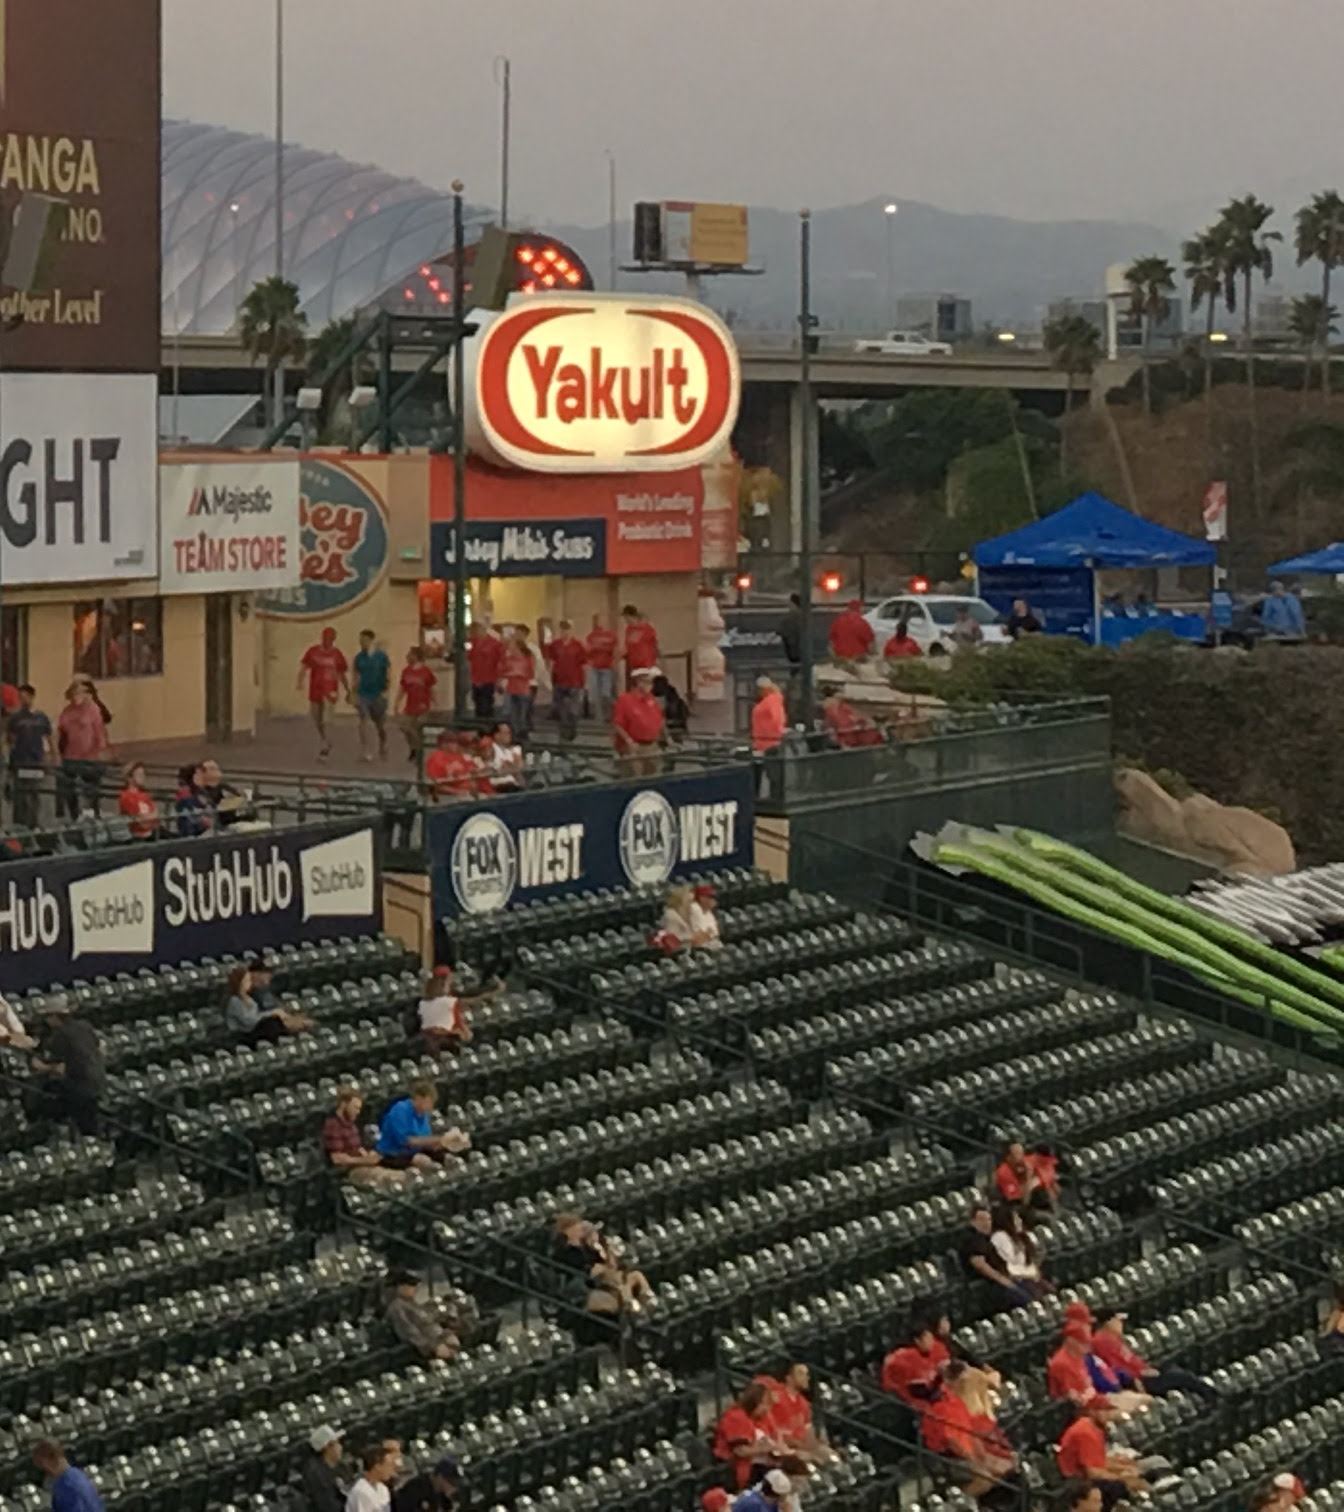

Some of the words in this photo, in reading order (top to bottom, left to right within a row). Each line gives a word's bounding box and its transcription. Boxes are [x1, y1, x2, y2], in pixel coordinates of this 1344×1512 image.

[53, 288, 102, 324] Level
[521, 345, 698, 426] Yakult
[212, 485, 273, 524] Majestic
[173, 530, 225, 574] TEAM
[227, 535, 287, 572] STORE
[630, 810, 666, 851] FOX
[678, 800, 739, 862] WEST
[464, 832, 503, 879] FOX
[517, 823, 585, 888] WEST
[162, 845, 294, 928] StubHub
[309, 860, 366, 896] StubHub
[80, 898, 144, 932] StubHub
